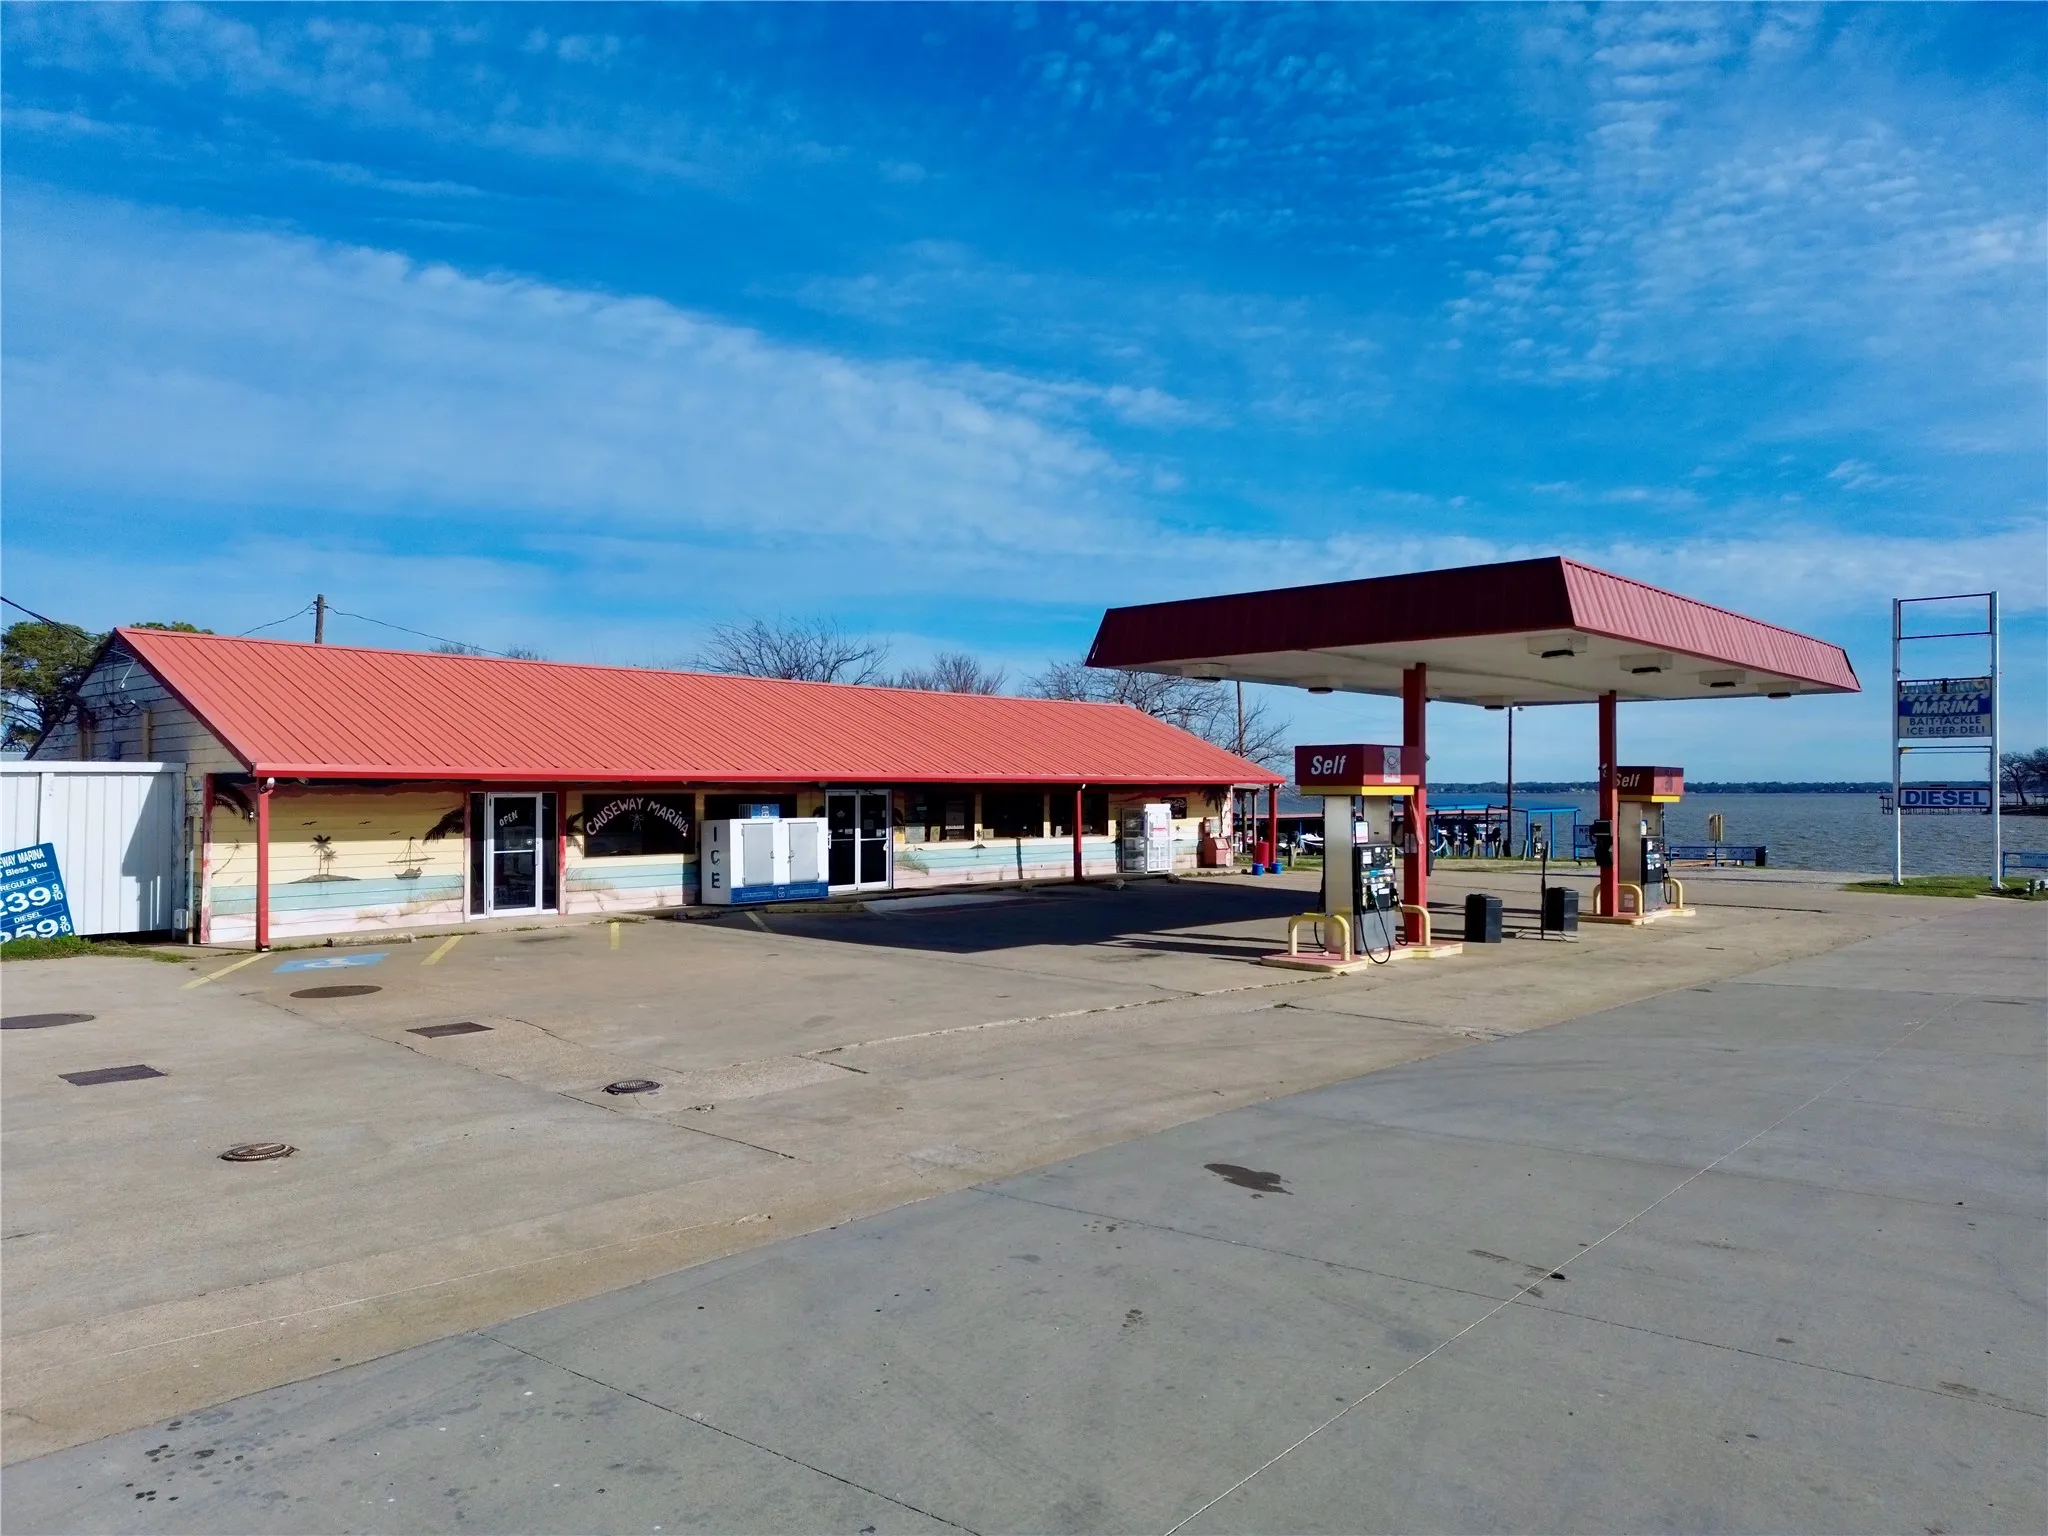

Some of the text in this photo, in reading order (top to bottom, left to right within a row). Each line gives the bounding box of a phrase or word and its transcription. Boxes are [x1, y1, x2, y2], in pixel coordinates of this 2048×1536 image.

[1911, 699, 1979, 714] MARINA
[1310, 755, 1347, 776] Self
[1905, 790, 1987, 806] DIESEL
[499, 809, 518, 827] OPEN
[586, 798, 645, 836] CAUSEWAY
[17, 848, 45, 864] MARINA
[5, 866, 29, 876] Bless
[31, 862, 47, 870] You
[0, 877, 38, 891] REGULAR
[14, 911, 42, 924] DIESEL
